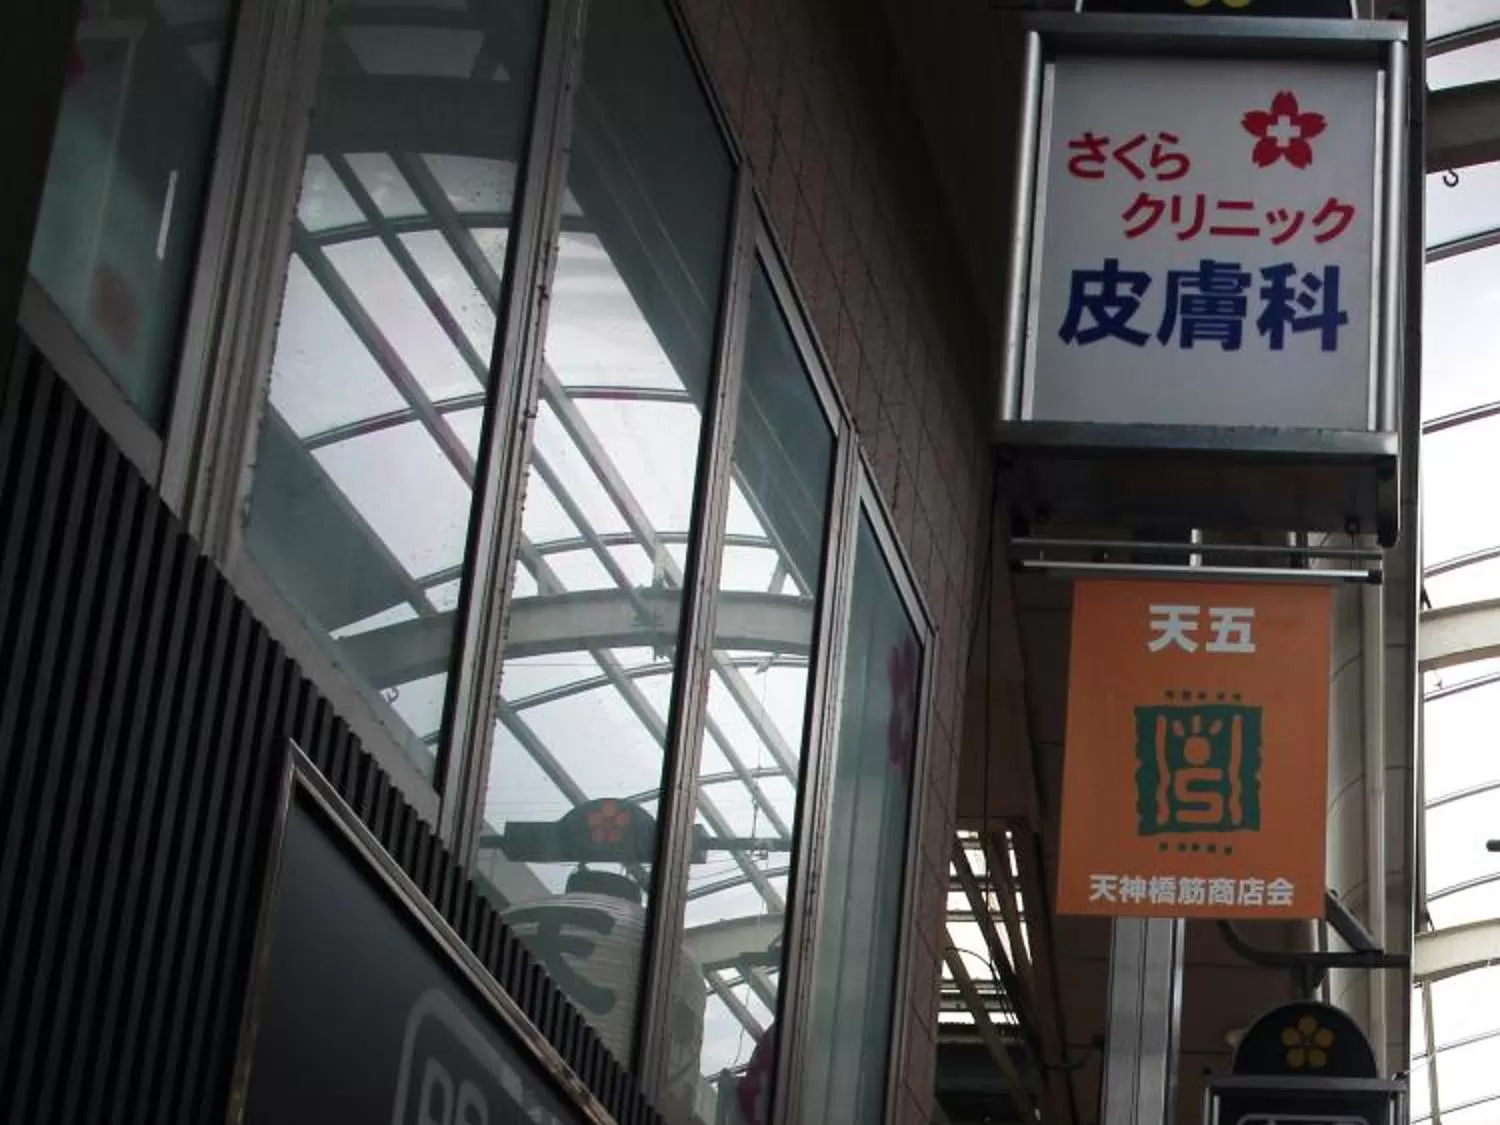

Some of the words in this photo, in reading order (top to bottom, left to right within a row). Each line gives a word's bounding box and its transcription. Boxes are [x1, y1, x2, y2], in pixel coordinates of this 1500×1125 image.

[1067, 131, 1191, 181] さくら
[1122, 192, 1355, 246] クリニック
[1058, 258, 1348, 352] 皮膚科
[1147, 603, 1256, 654] 天五
[1088, 873, 1295, 907] 天神橋筋商店会
